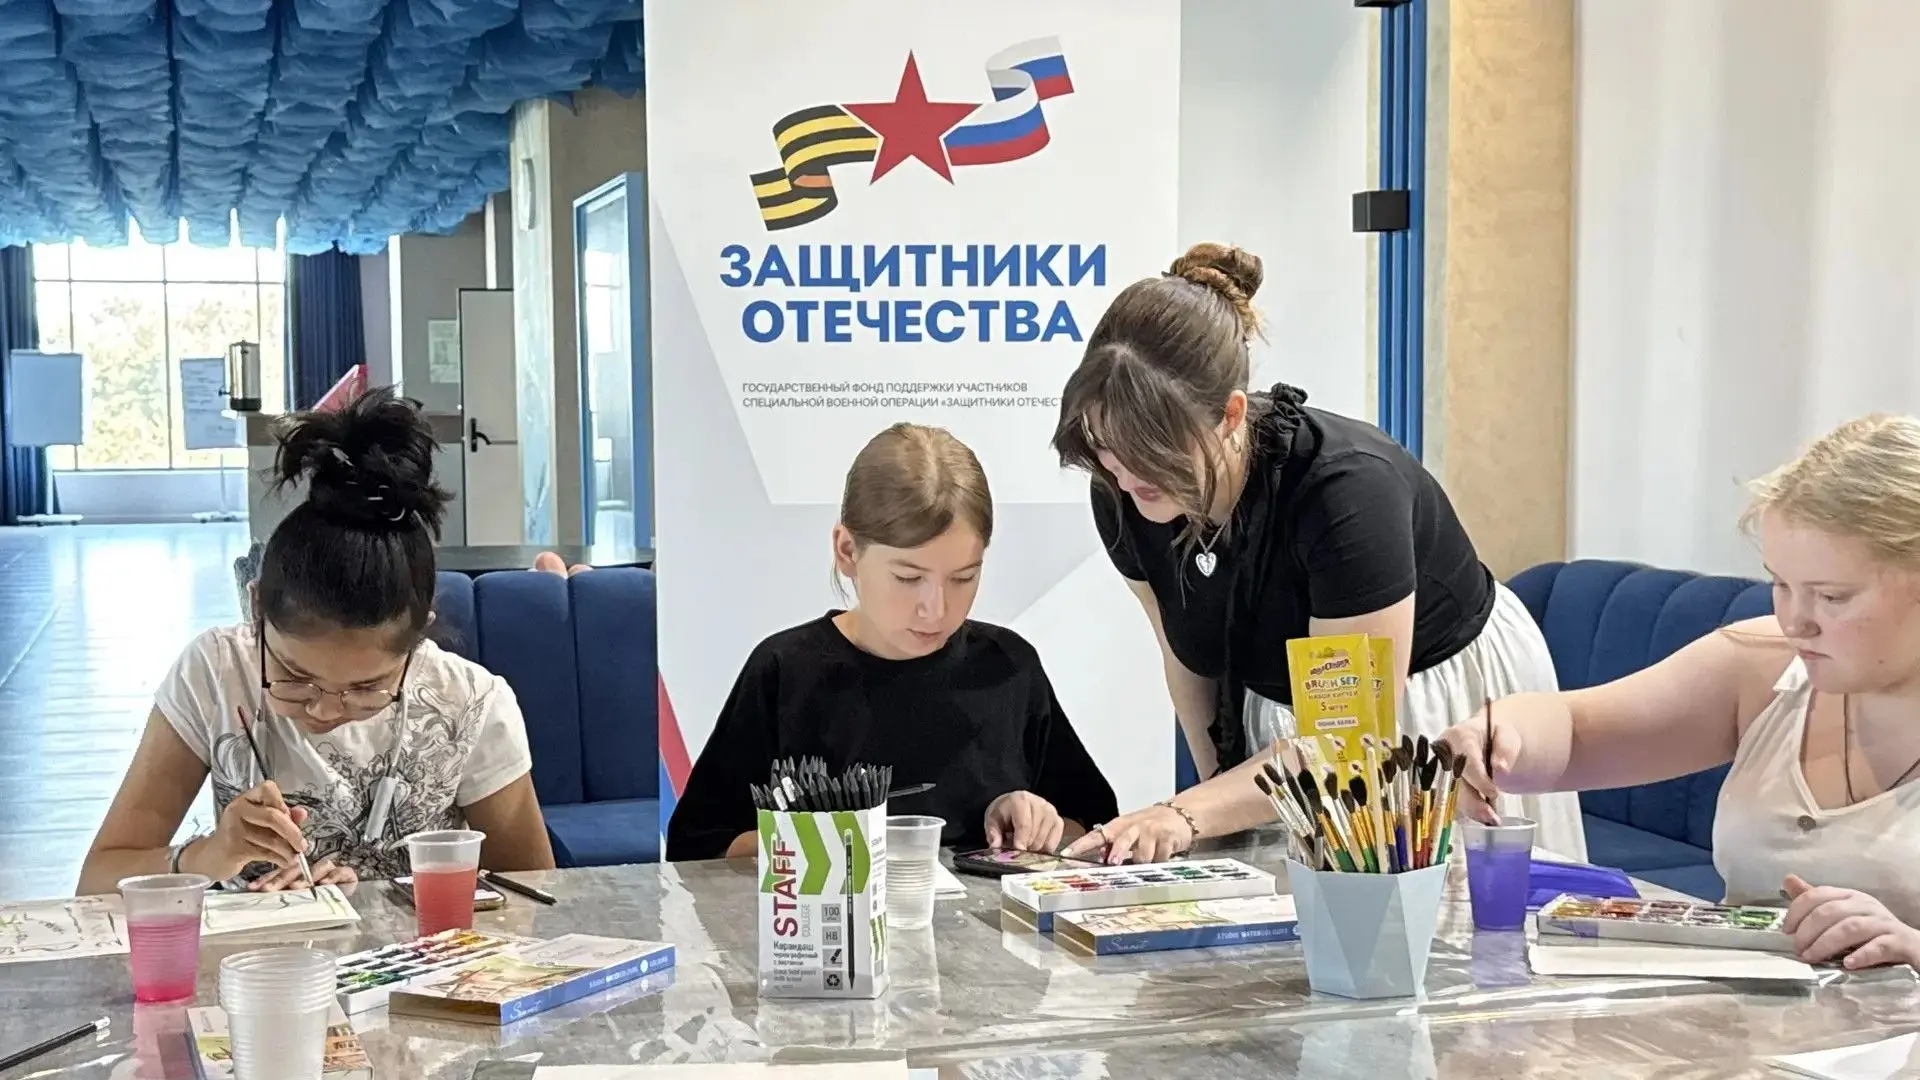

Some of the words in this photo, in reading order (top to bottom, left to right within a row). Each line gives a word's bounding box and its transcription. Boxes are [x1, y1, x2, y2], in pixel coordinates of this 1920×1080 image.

[720, 244, 1106, 292] ЗАЩИТНИКИ
[741, 300, 1083, 343] ОТЕЧЕСТВА
[742, 382, 850, 394] ГОСУДАРСТВЕННЫЙ
[852, 383, 884, 394] ФОНД
[886, 383, 954, 394] ПОДДЕРЖКИ
[956, 383, 1028, 393] УЧАСТНИКОВ
[742, 396, 824, 408] СПЕЦИАЛЬНОЙ
[826, 396, 878, 408] ВОЕННОЙ
[880, 397, 938, 408] ОПЕРАЦИИ
[941, 397, 1015, 408] «ЗАЩИТНИКИ
[1305, 679, 1338, 690] BRUSH
[1340, 676, 1358, 686] SET
[773, 840, 798, 937] STAFF
[824, 907, 840, 916] 100
[773, 941, 814, 951] Карандаш
